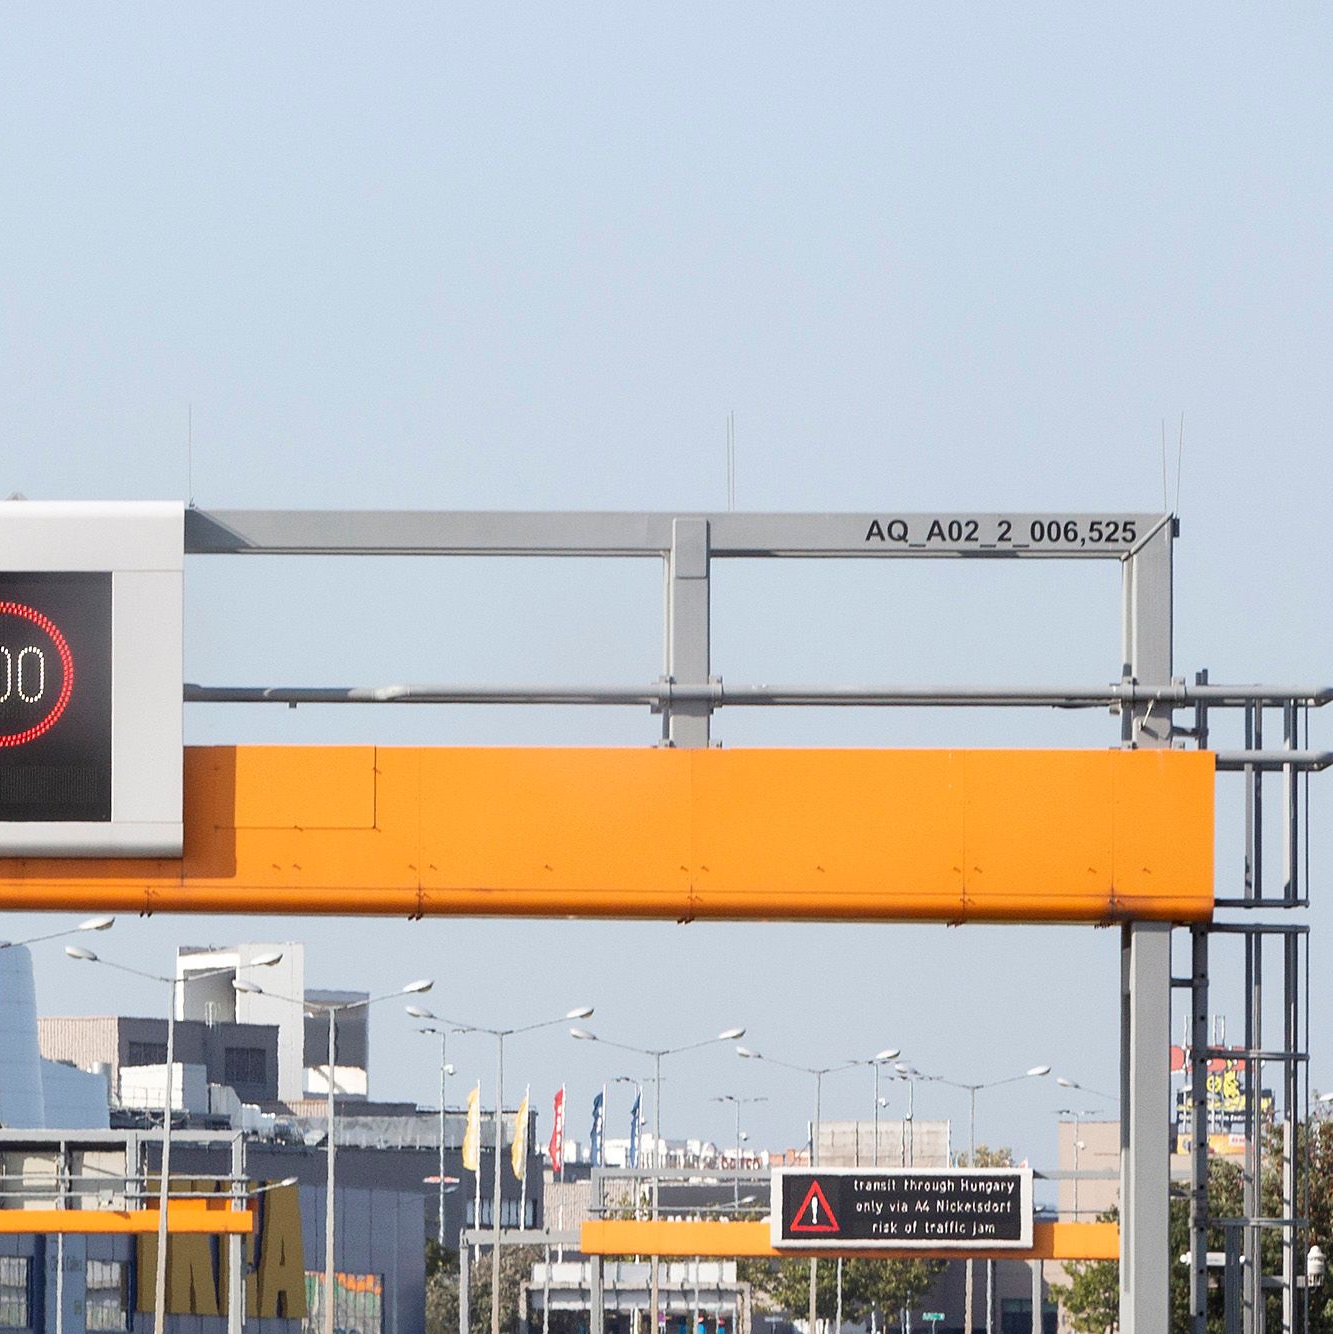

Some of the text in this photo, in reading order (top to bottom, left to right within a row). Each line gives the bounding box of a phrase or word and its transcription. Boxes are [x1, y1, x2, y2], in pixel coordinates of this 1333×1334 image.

[854, 1178, 1015, 1195] transit through Hungary
[856, 1200, 884, 1215] only
[889, 1200, 908, 1213] via
[915, 1200, 930, 1213] A4
[872, 1221, 996, 1237] risk of traffic jam
